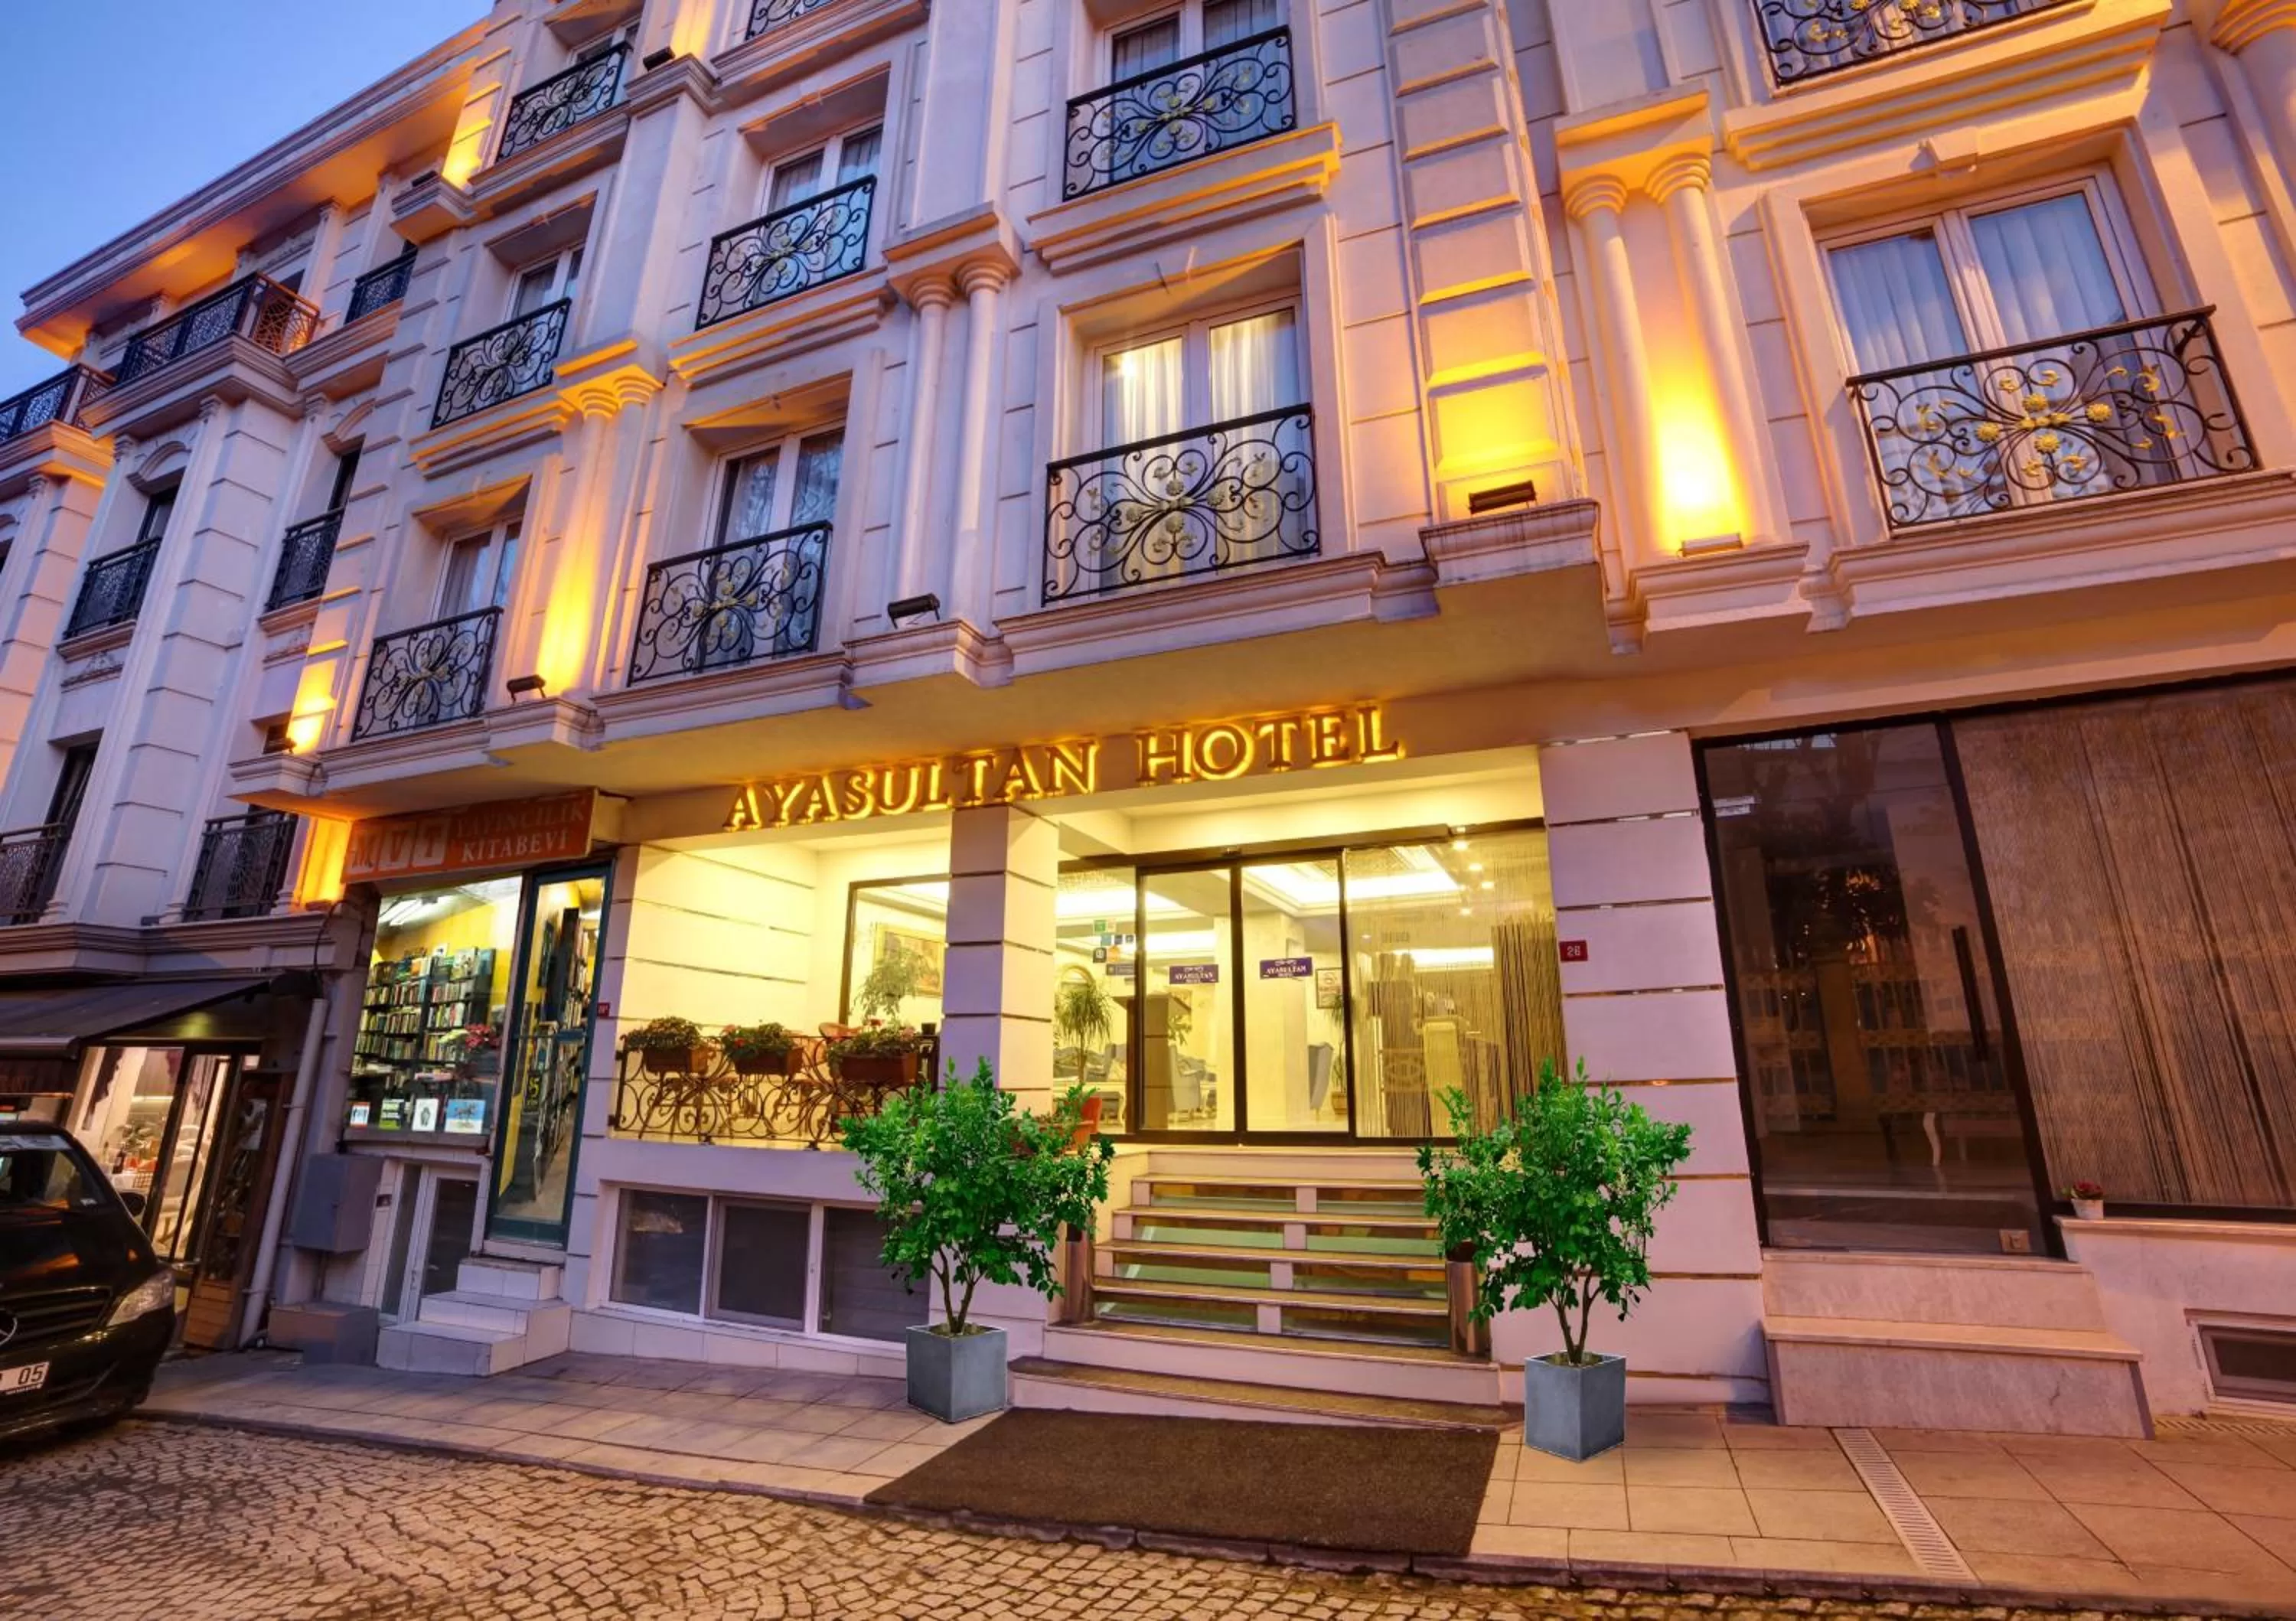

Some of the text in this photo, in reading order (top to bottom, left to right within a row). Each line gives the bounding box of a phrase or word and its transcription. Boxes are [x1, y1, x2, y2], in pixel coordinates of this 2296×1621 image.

[723, 700, 1405, 831] AYASULTAN HOTEL
[18, 1365, 44, 1385] 05
